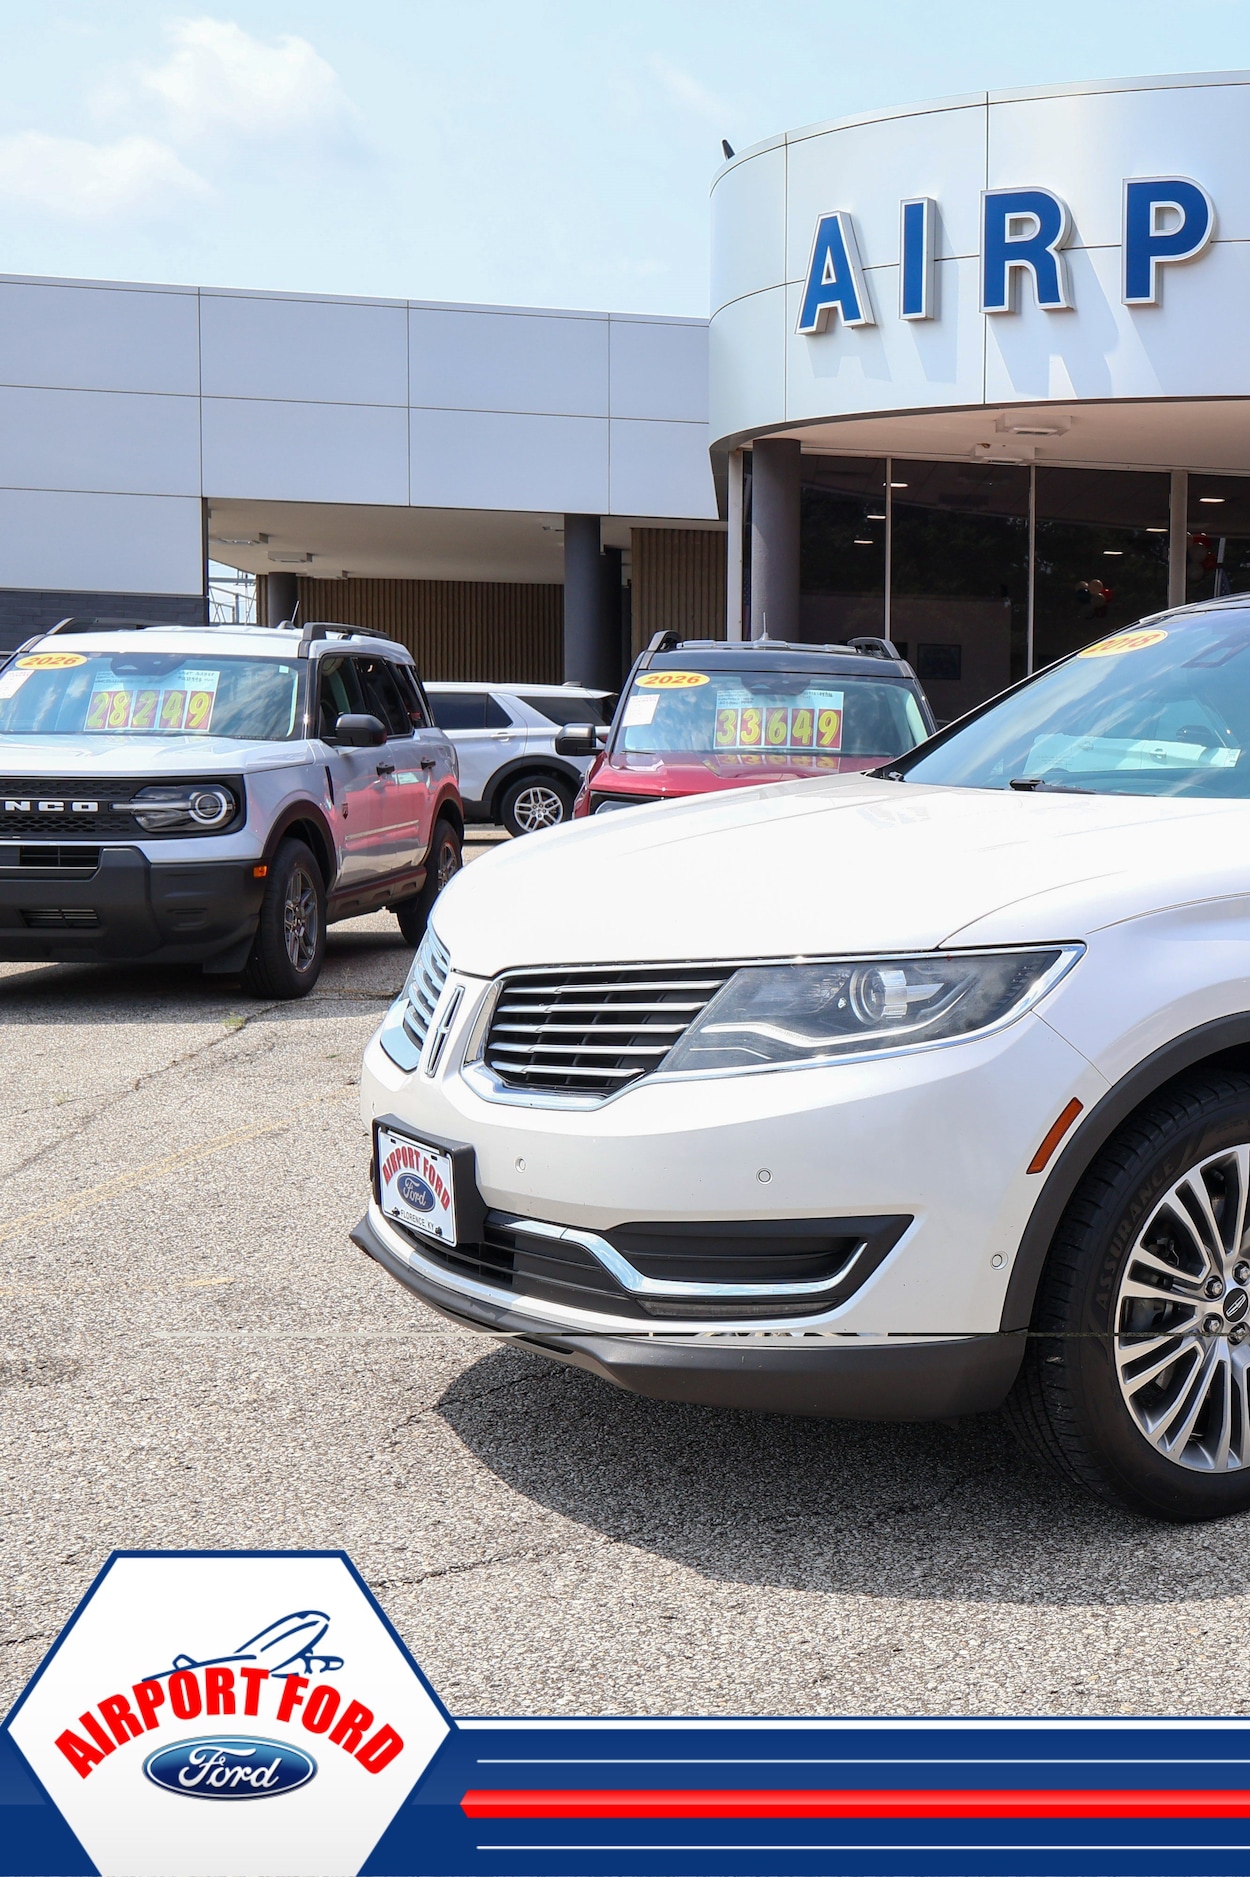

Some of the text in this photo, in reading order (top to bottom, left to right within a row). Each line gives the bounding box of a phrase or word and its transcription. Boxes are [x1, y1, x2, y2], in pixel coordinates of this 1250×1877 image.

[22, 655, 78, 667] 2026
[644, 673, 701, 685] 2026
[87, 691, 211, 729] 28249
[715, 709, 841, 746] 33649
[5, 801, 99, 812] NCO
[382, 1146, 451, 1212] AIRPORT FORD
[402, 1177, 427, 1207] Ford
